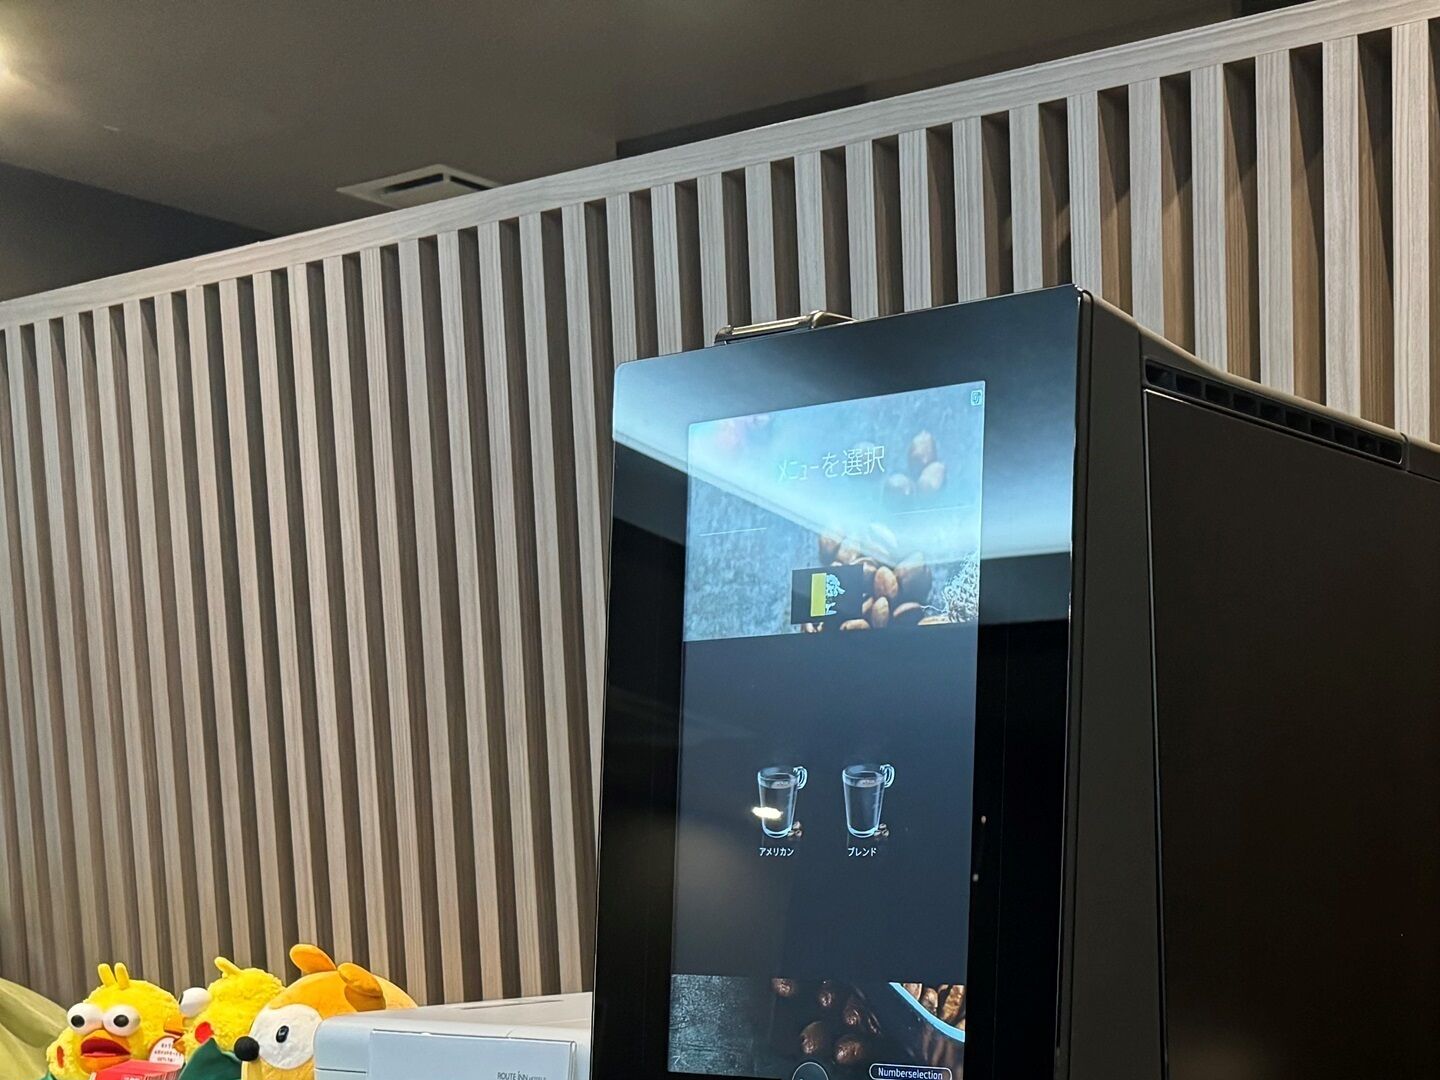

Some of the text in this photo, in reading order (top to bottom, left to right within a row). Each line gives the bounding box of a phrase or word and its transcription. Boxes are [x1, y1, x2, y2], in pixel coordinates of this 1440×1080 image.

[777, 445, 886, 482] メニューを選択
[758, 846, 794, 858] アメリカン
[847, 846, 877, 858] ブレンド
[877, 1066, 944, 1080] Numberselection
